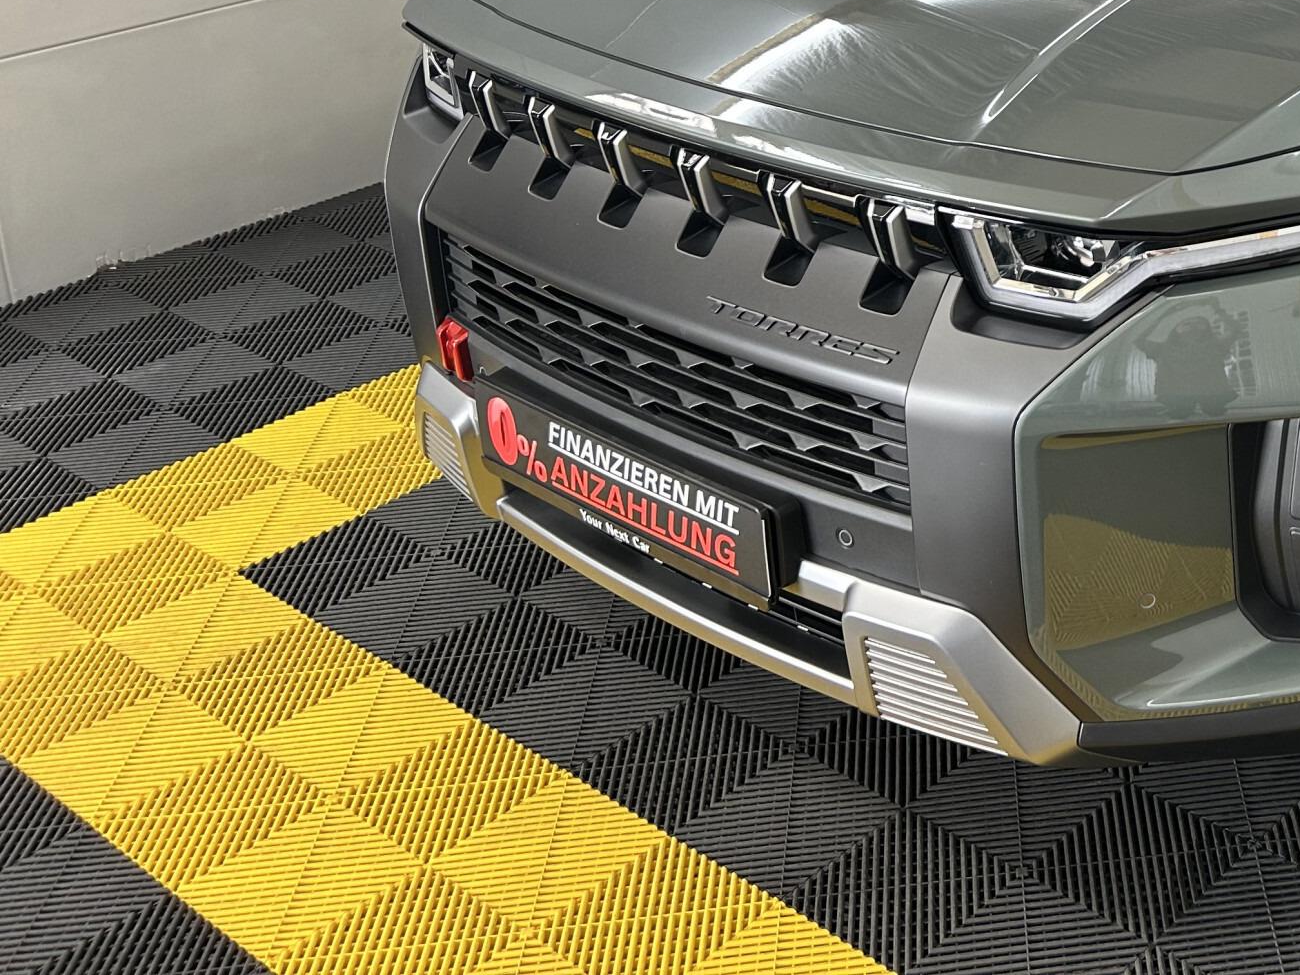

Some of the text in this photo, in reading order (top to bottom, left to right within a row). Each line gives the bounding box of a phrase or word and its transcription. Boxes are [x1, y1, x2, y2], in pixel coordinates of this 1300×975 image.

[706, 295, 901, 365] TORRES
[487, 396, 548, 483] 0%
[548, 421, 740, 528] FINANZIEREN MIT
[550, 456, 736, 569] ANZAHLUNG
[579, 508, 651, 554] Your Next Car
